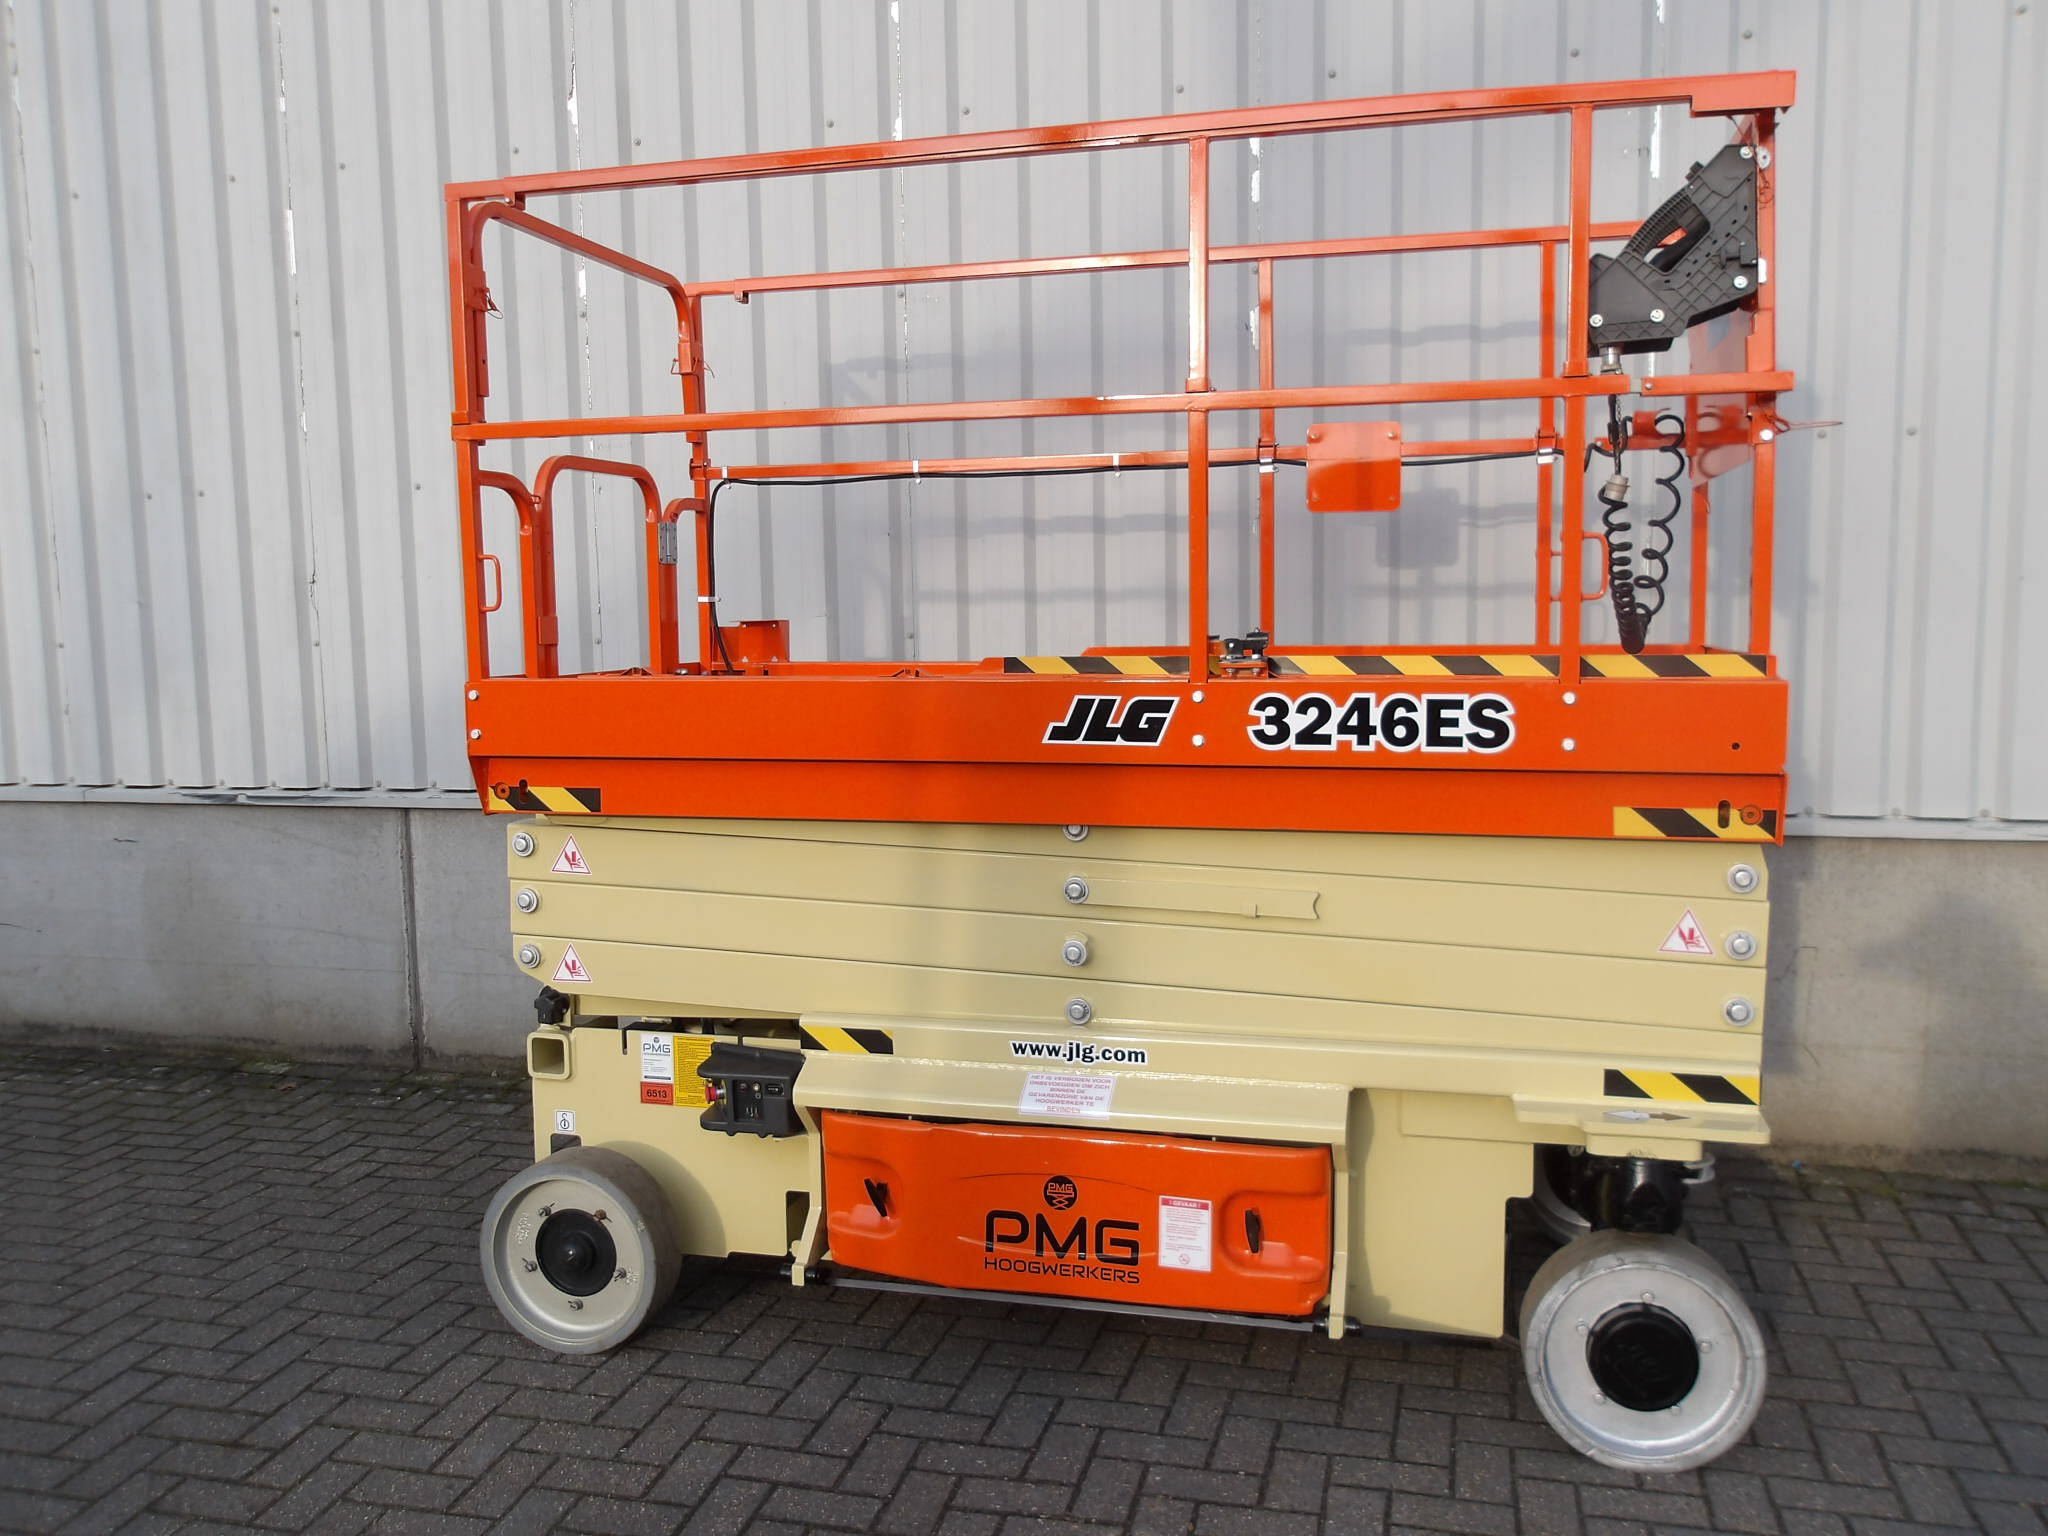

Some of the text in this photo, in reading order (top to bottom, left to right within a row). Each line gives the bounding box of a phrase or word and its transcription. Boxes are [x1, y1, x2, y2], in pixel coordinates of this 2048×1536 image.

[1046, 697, 1177, 744] JLG
[1250, 695, 1511, 749] 3246ES
[643, 1043, 671, 1053] PMG
[1011, 1041, 1146, 1063] www.jlg.com
[646, 1089, 667, 1098] 6513
[1048, 1182, 1074, 1191] PMG
[984, 1209, 1140, 1267] PMG
[984, 1257, 1140, 1284] HOOGWERKERS
